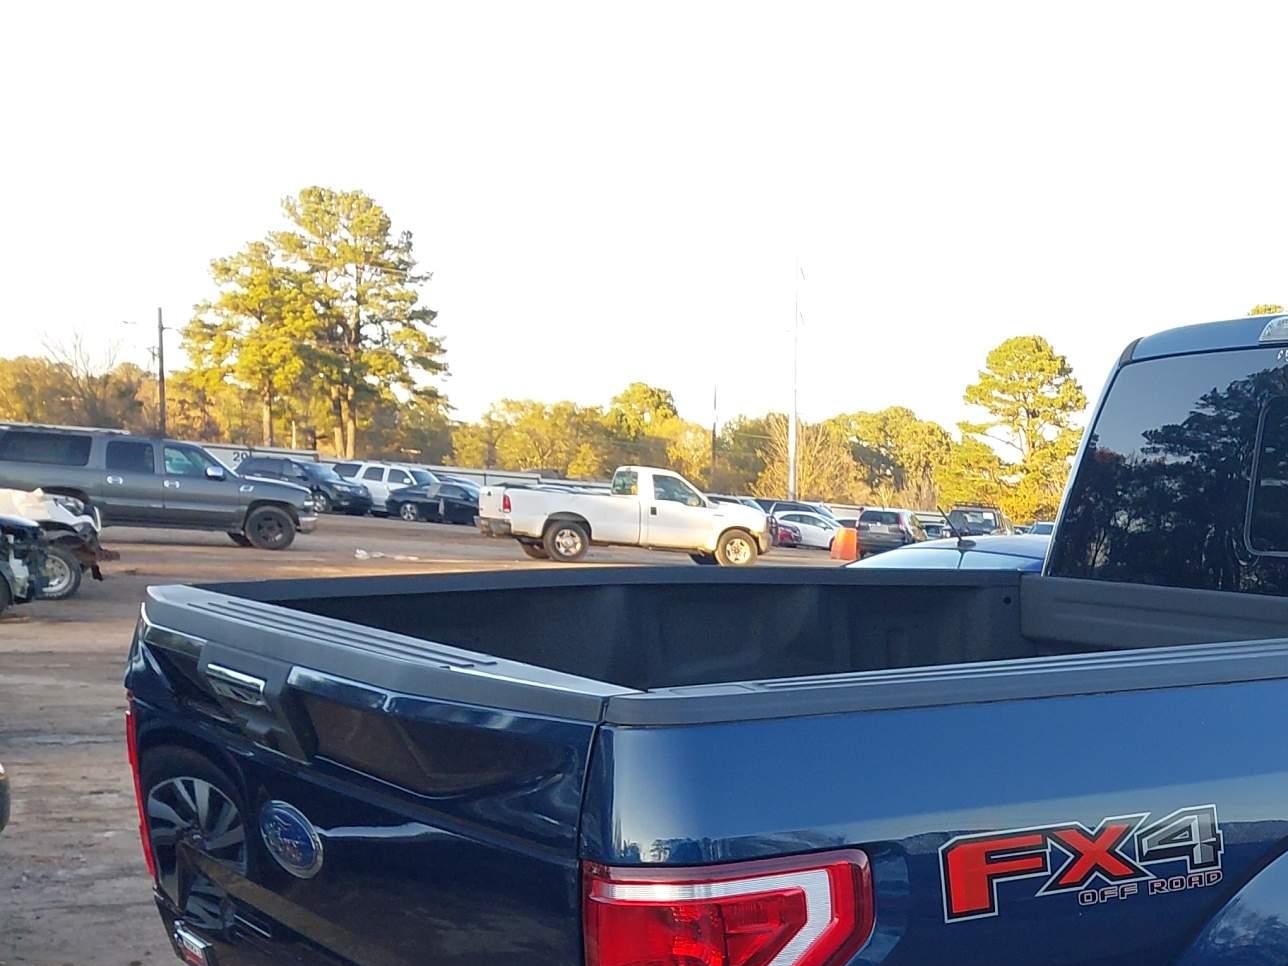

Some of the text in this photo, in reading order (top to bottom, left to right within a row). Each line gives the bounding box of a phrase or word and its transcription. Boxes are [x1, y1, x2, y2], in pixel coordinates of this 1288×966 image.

[938, 803, 1224, 924] FX4
[1078, 870, 1223, 906] OFF ROAD
